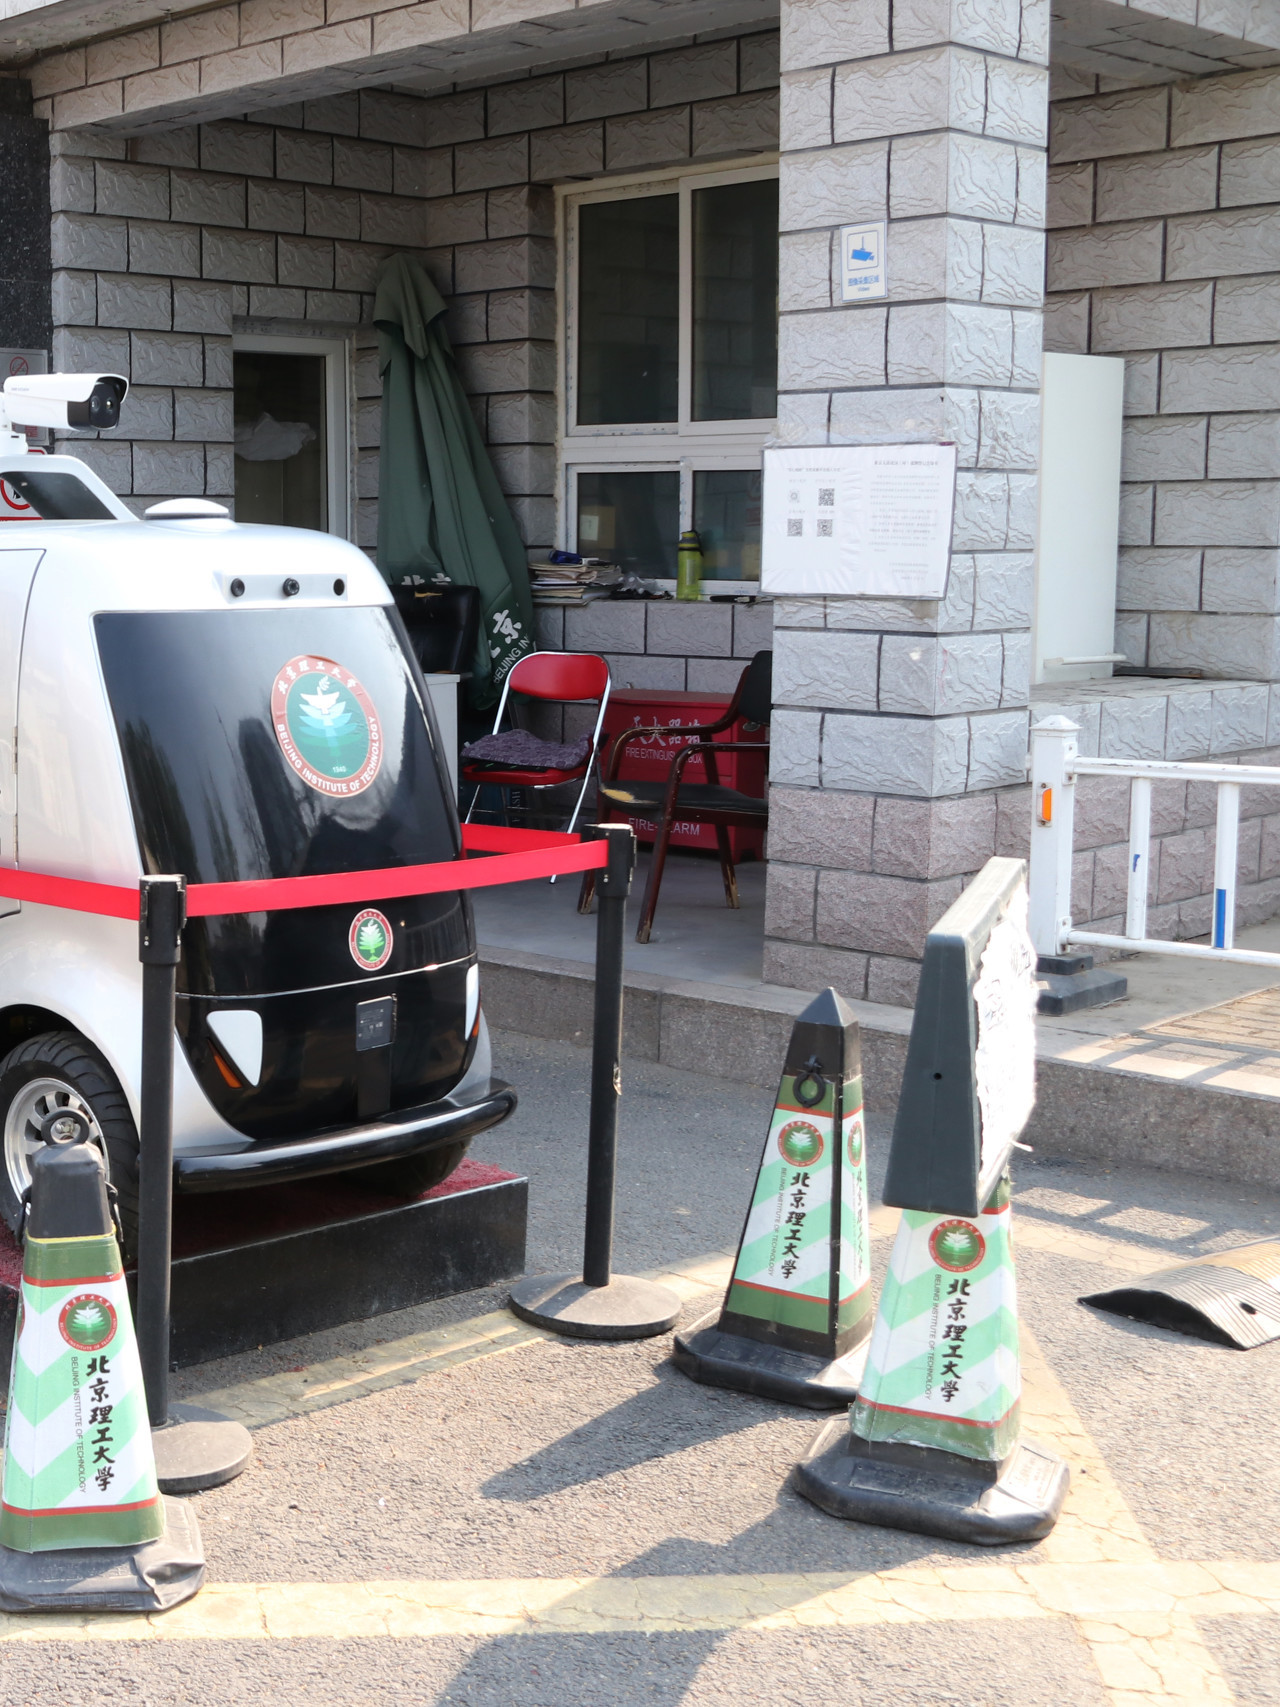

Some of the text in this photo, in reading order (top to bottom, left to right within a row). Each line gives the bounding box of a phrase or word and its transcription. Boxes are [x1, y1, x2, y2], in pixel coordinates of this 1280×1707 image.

[277, 716, 380, 793] BEIJING INSTITUTE OF TECHNOLOGY
[71, 1356, 86, 1493] BEIJING INSTITUTE OF TECHNOLOGY
